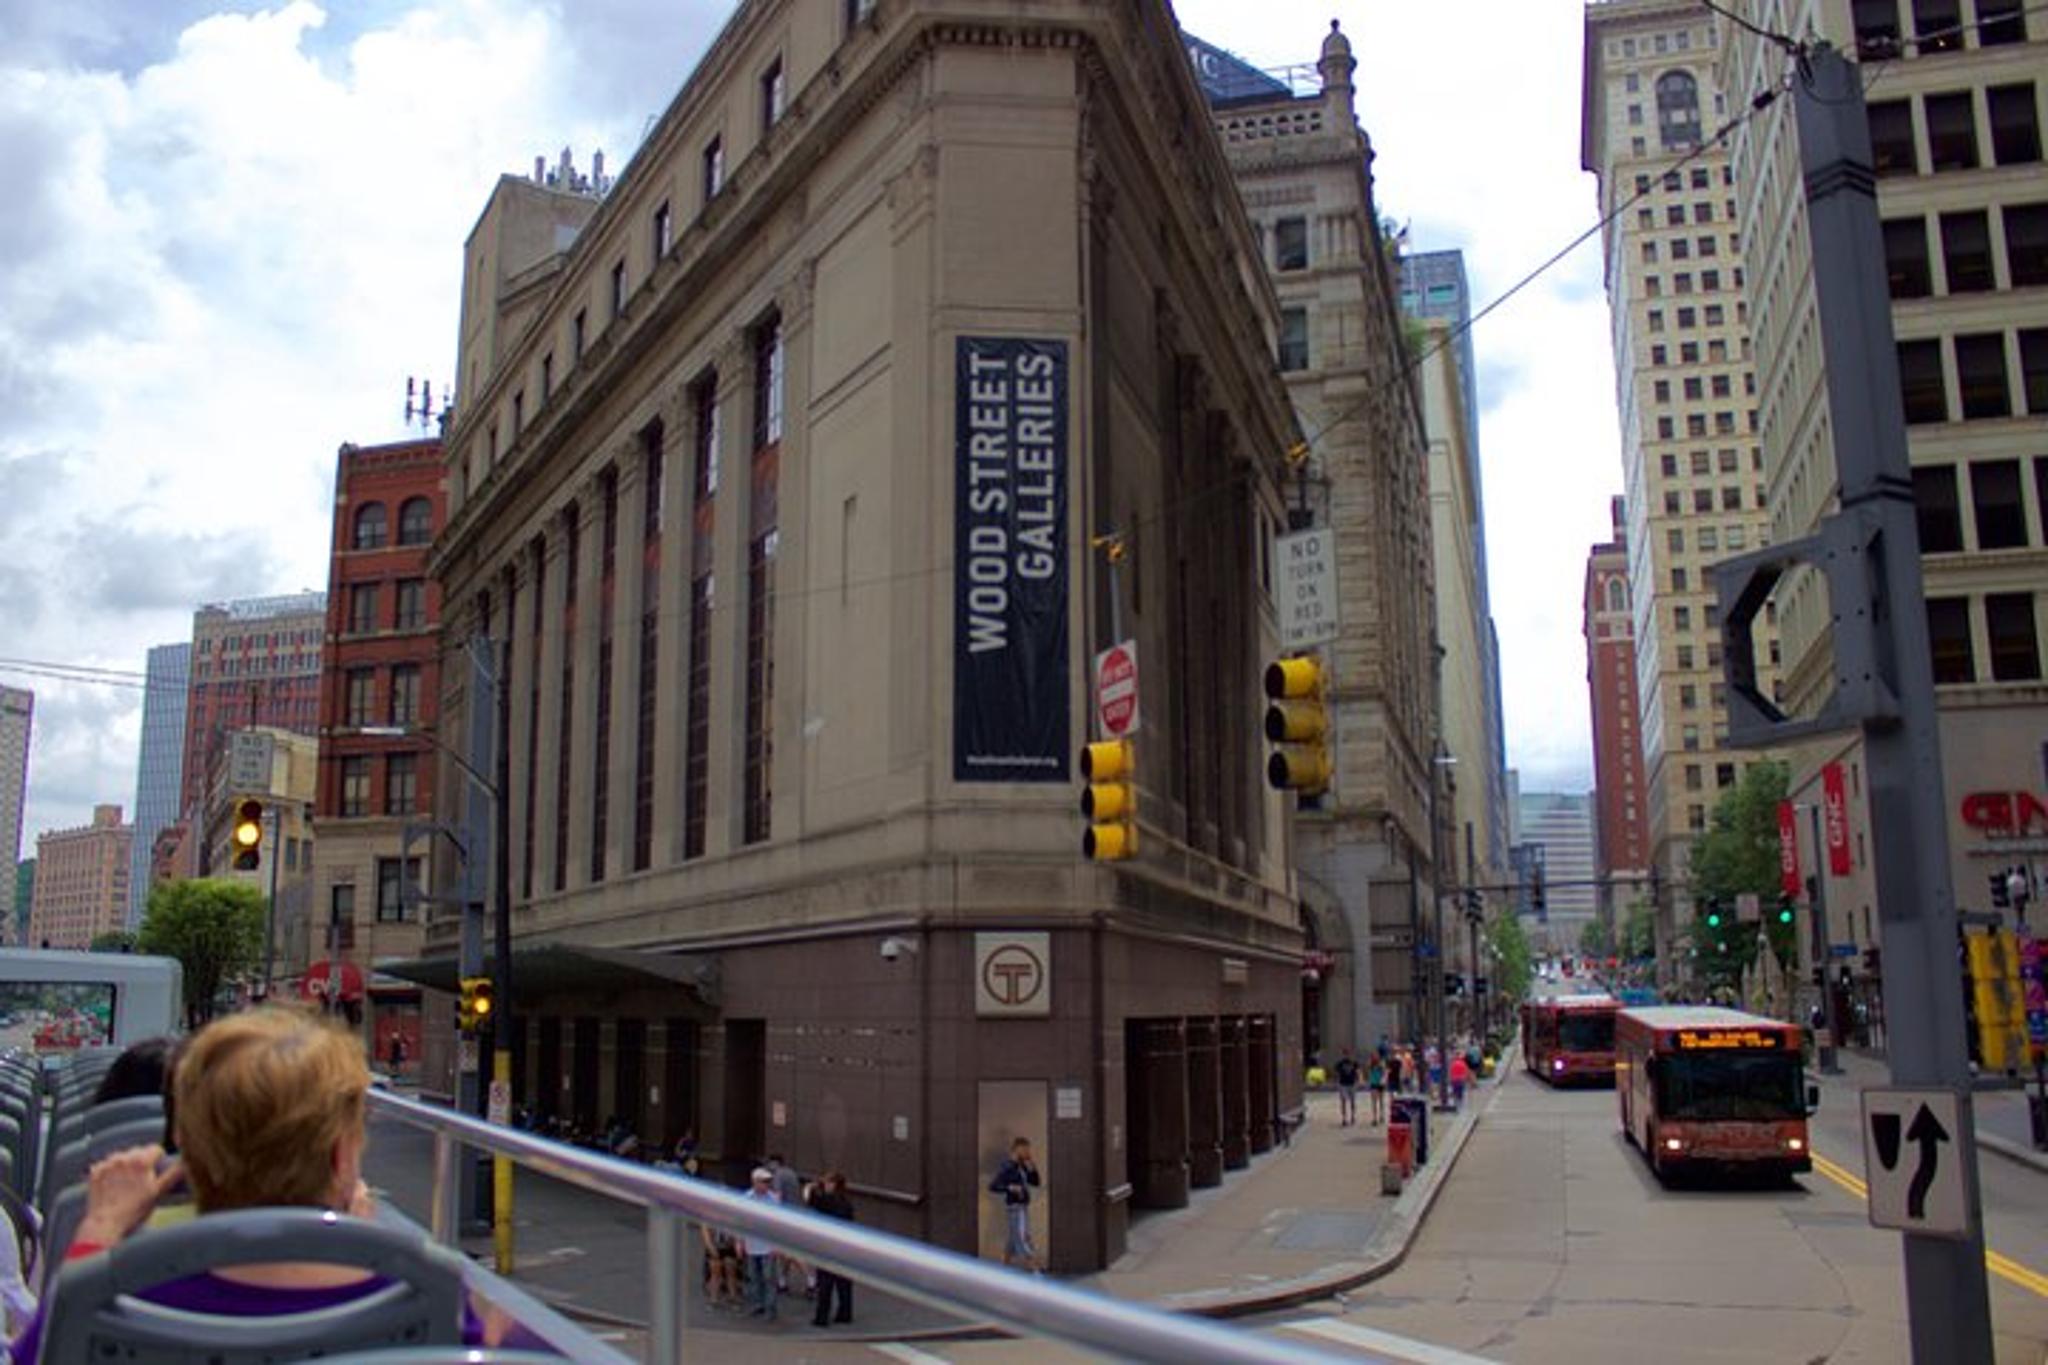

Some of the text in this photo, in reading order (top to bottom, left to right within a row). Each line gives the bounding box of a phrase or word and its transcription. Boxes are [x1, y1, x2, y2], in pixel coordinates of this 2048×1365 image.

[968, 352, 1007, 653] WOOD STREET
[1017, 354, 1054, 579] GALLERIES
[1290, 537, 1320, 559] NO
[1828, 792, 1844, 847] GNC
